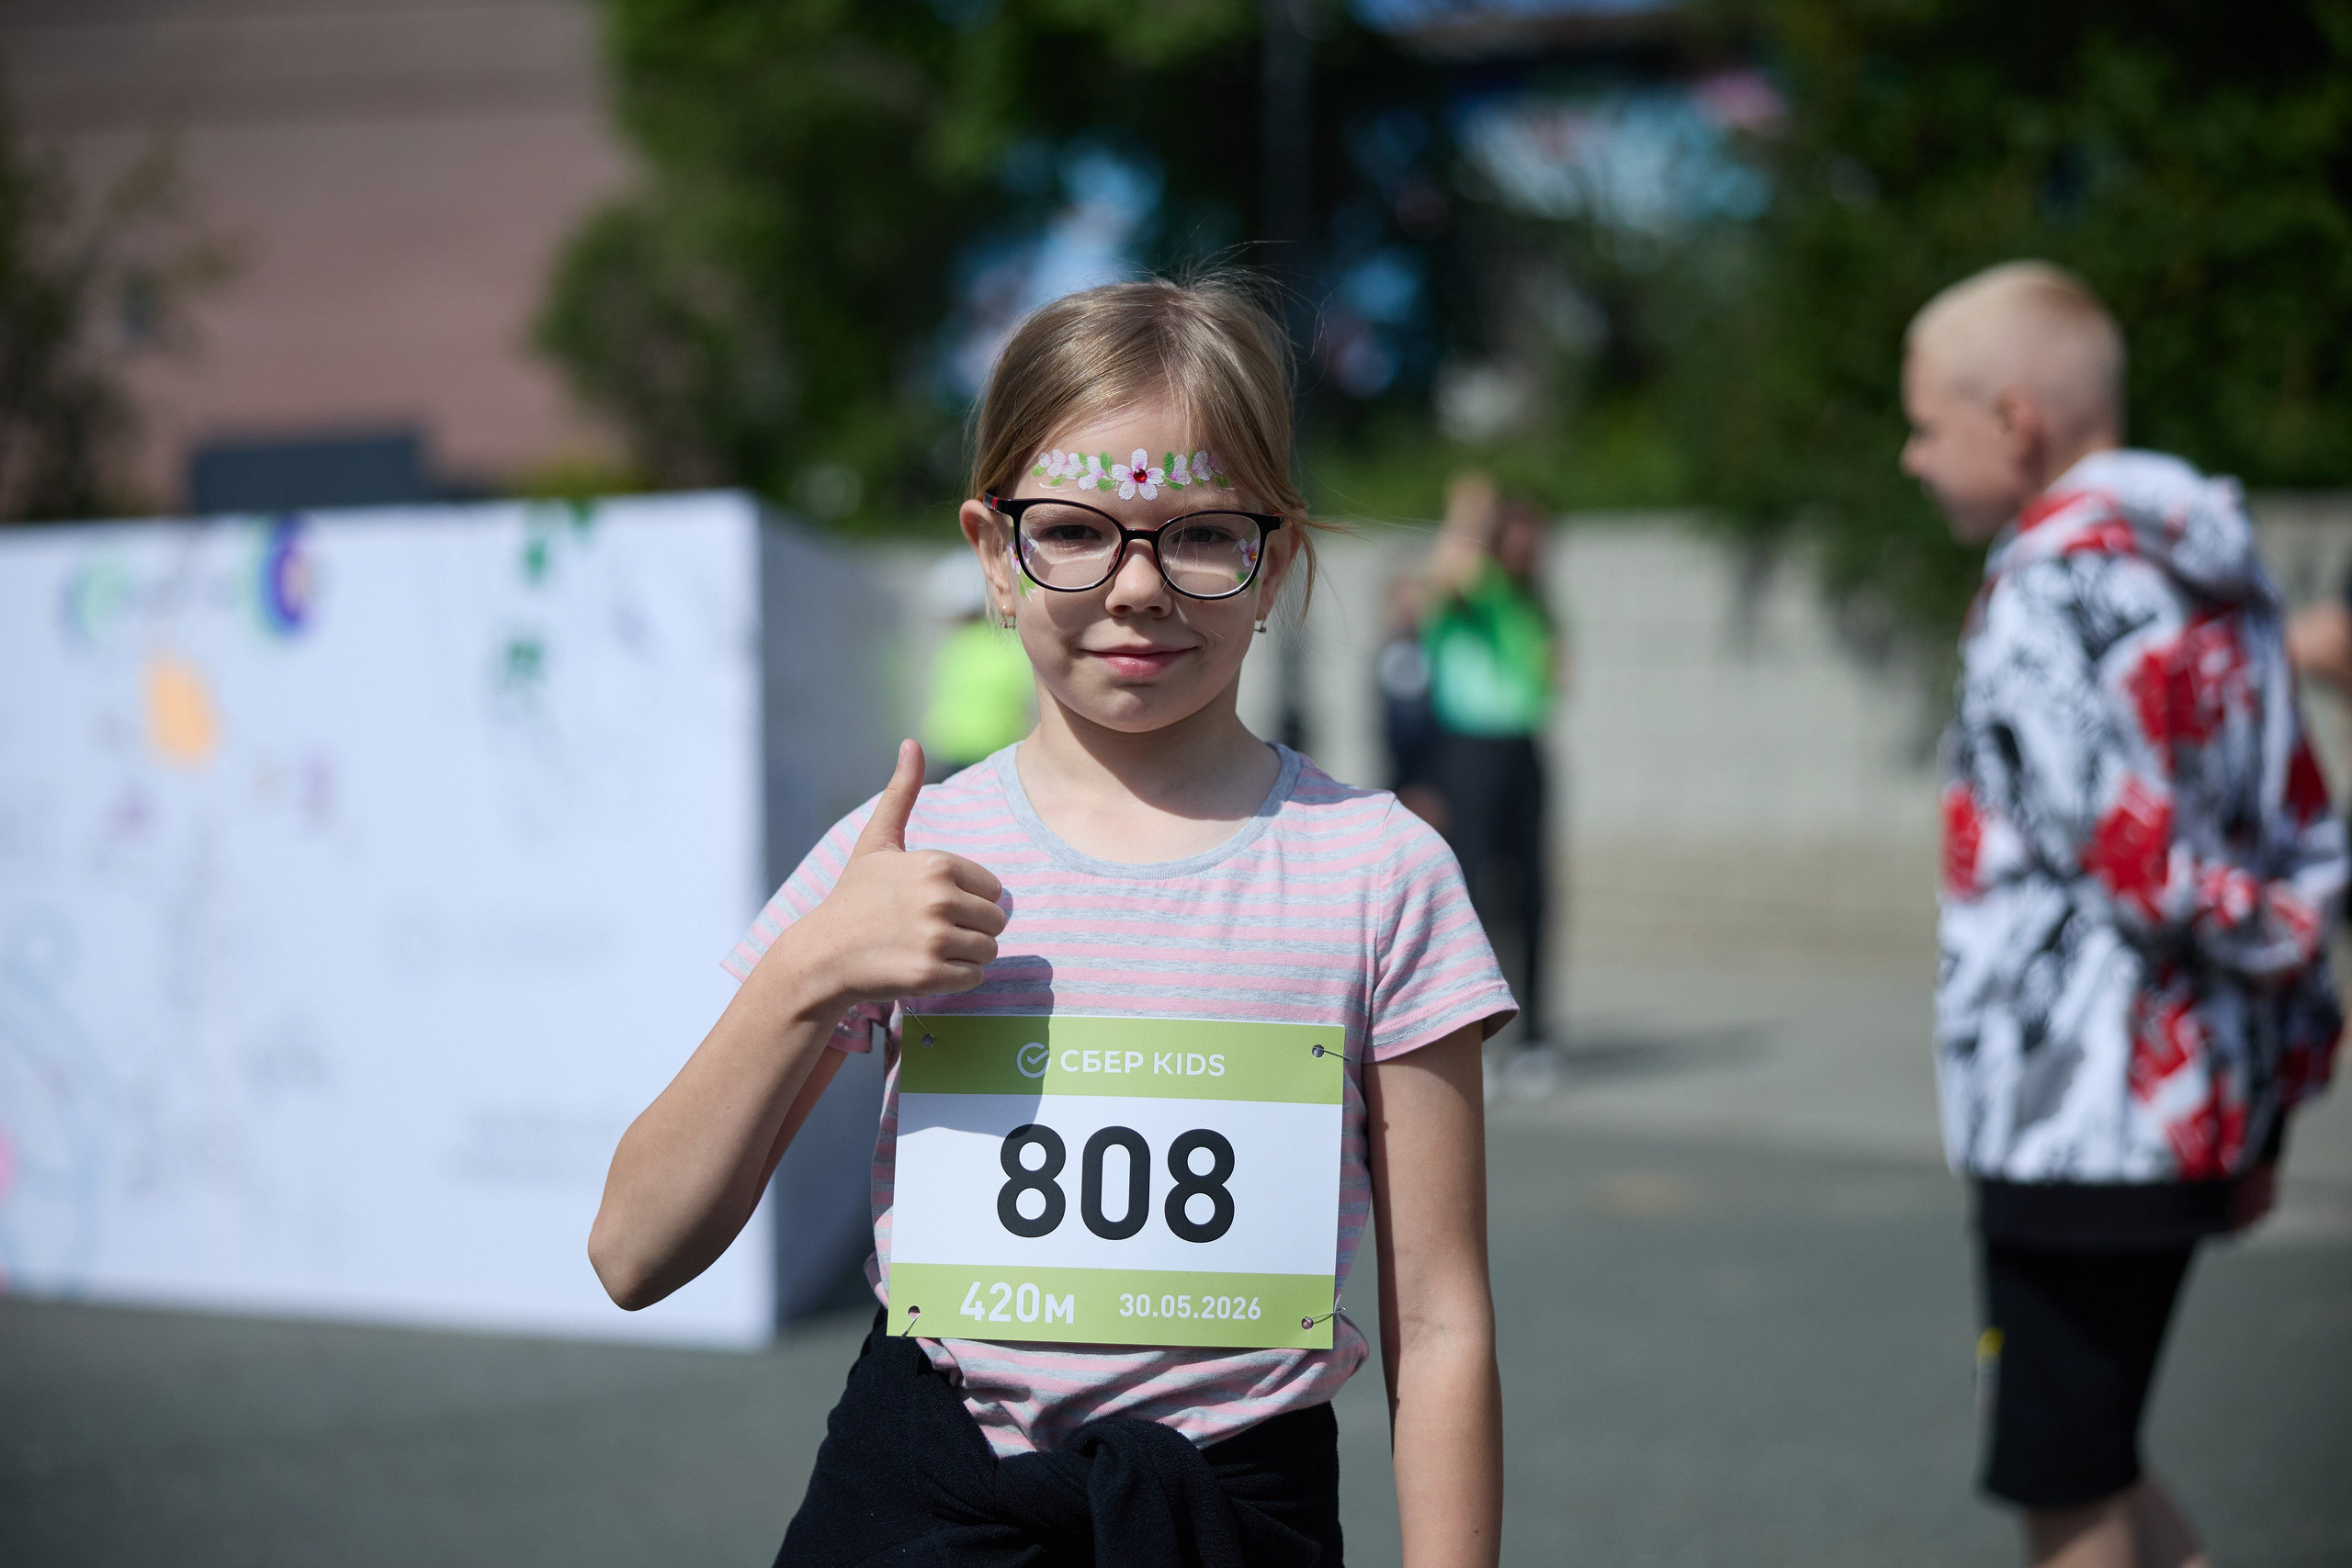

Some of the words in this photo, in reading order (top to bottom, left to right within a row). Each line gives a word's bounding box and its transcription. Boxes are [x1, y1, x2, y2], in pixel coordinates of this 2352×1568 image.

[1059, 1049, 1144, 1074] СБЕР
[1153, 1052, 1226, 1077] KIDS
[997, 1122, 1236, 1244] 808
[1119, 1293, 1261, 1321] 30.05.2026
